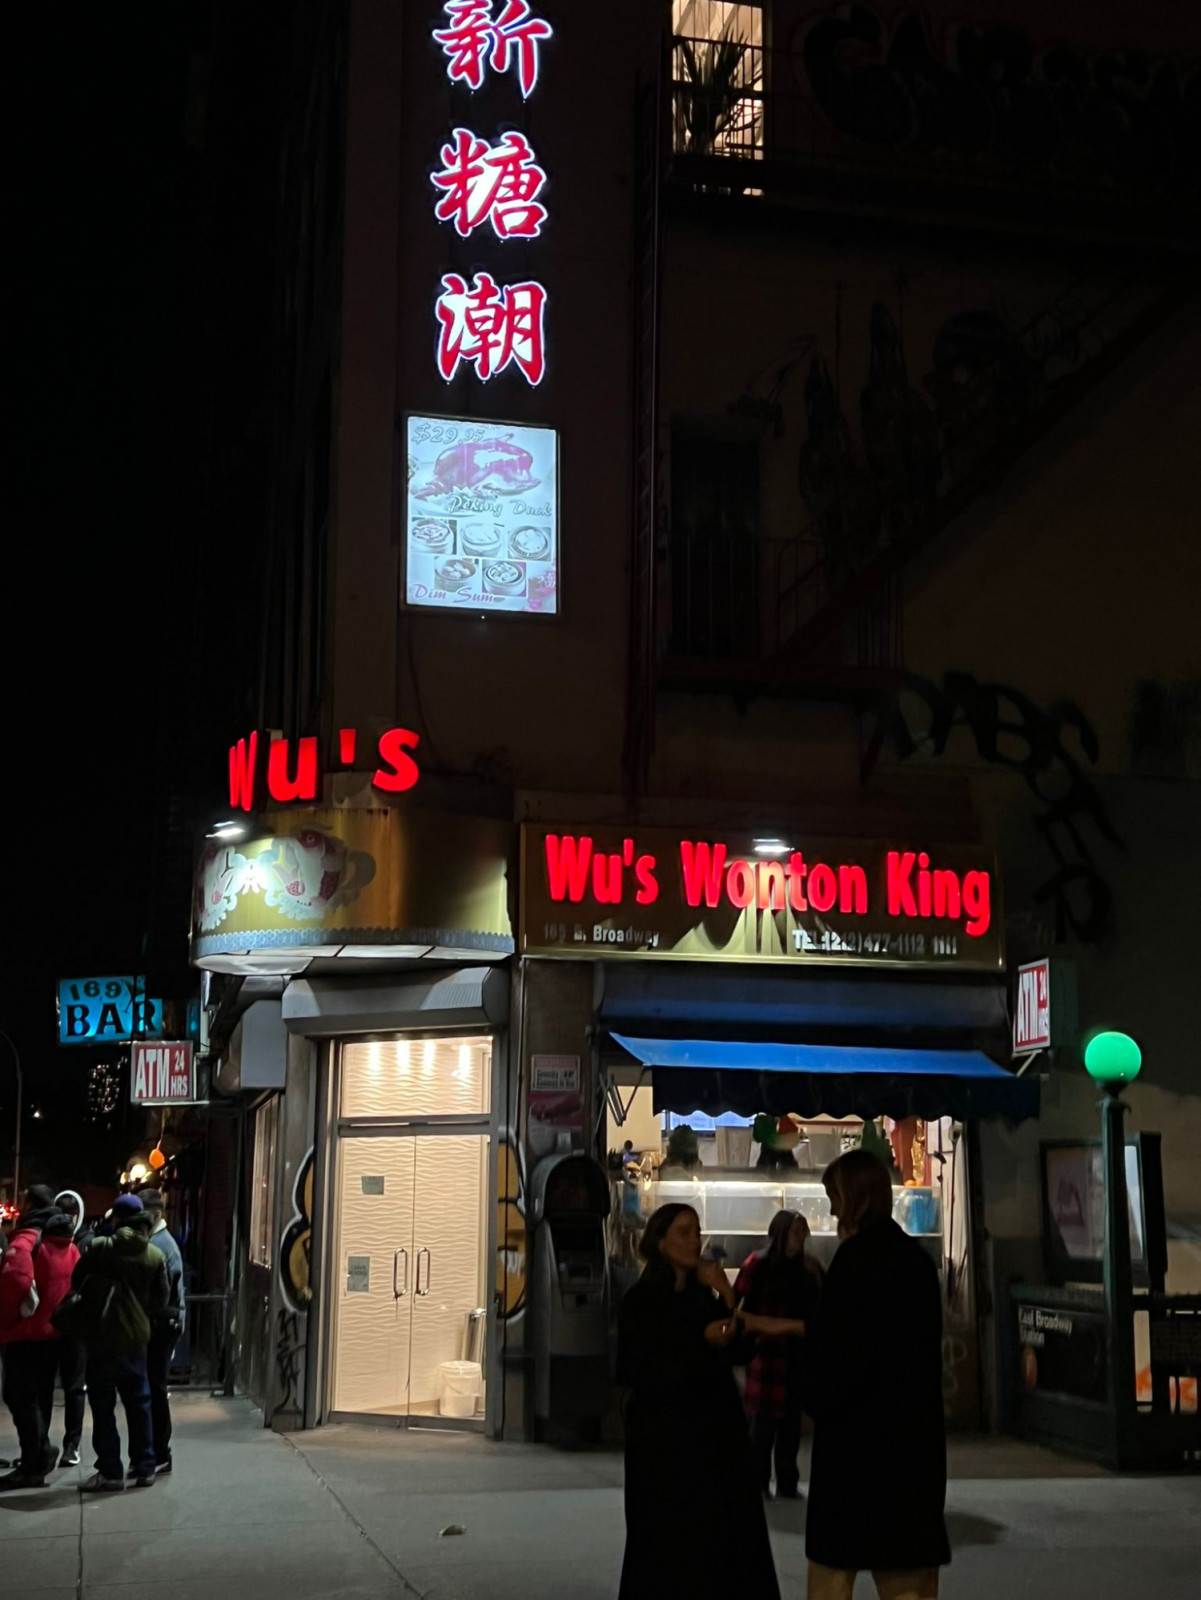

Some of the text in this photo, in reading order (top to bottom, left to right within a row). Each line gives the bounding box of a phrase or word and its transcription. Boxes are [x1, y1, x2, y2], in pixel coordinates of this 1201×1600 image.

[450, 494, 503, 517] Peking
[414, 583, 495, 604] Dim Sum
[229, 728, 420, 811] Wu's
[545, 834, 991, 937] Wu's Wonton King
[69, 980, 122, 1000] 169
[66, 1002, 156, 1037] BAR
[135, 1048, 185, 1098] ATM 24
[170, 1074, 188, 1096] HRS
